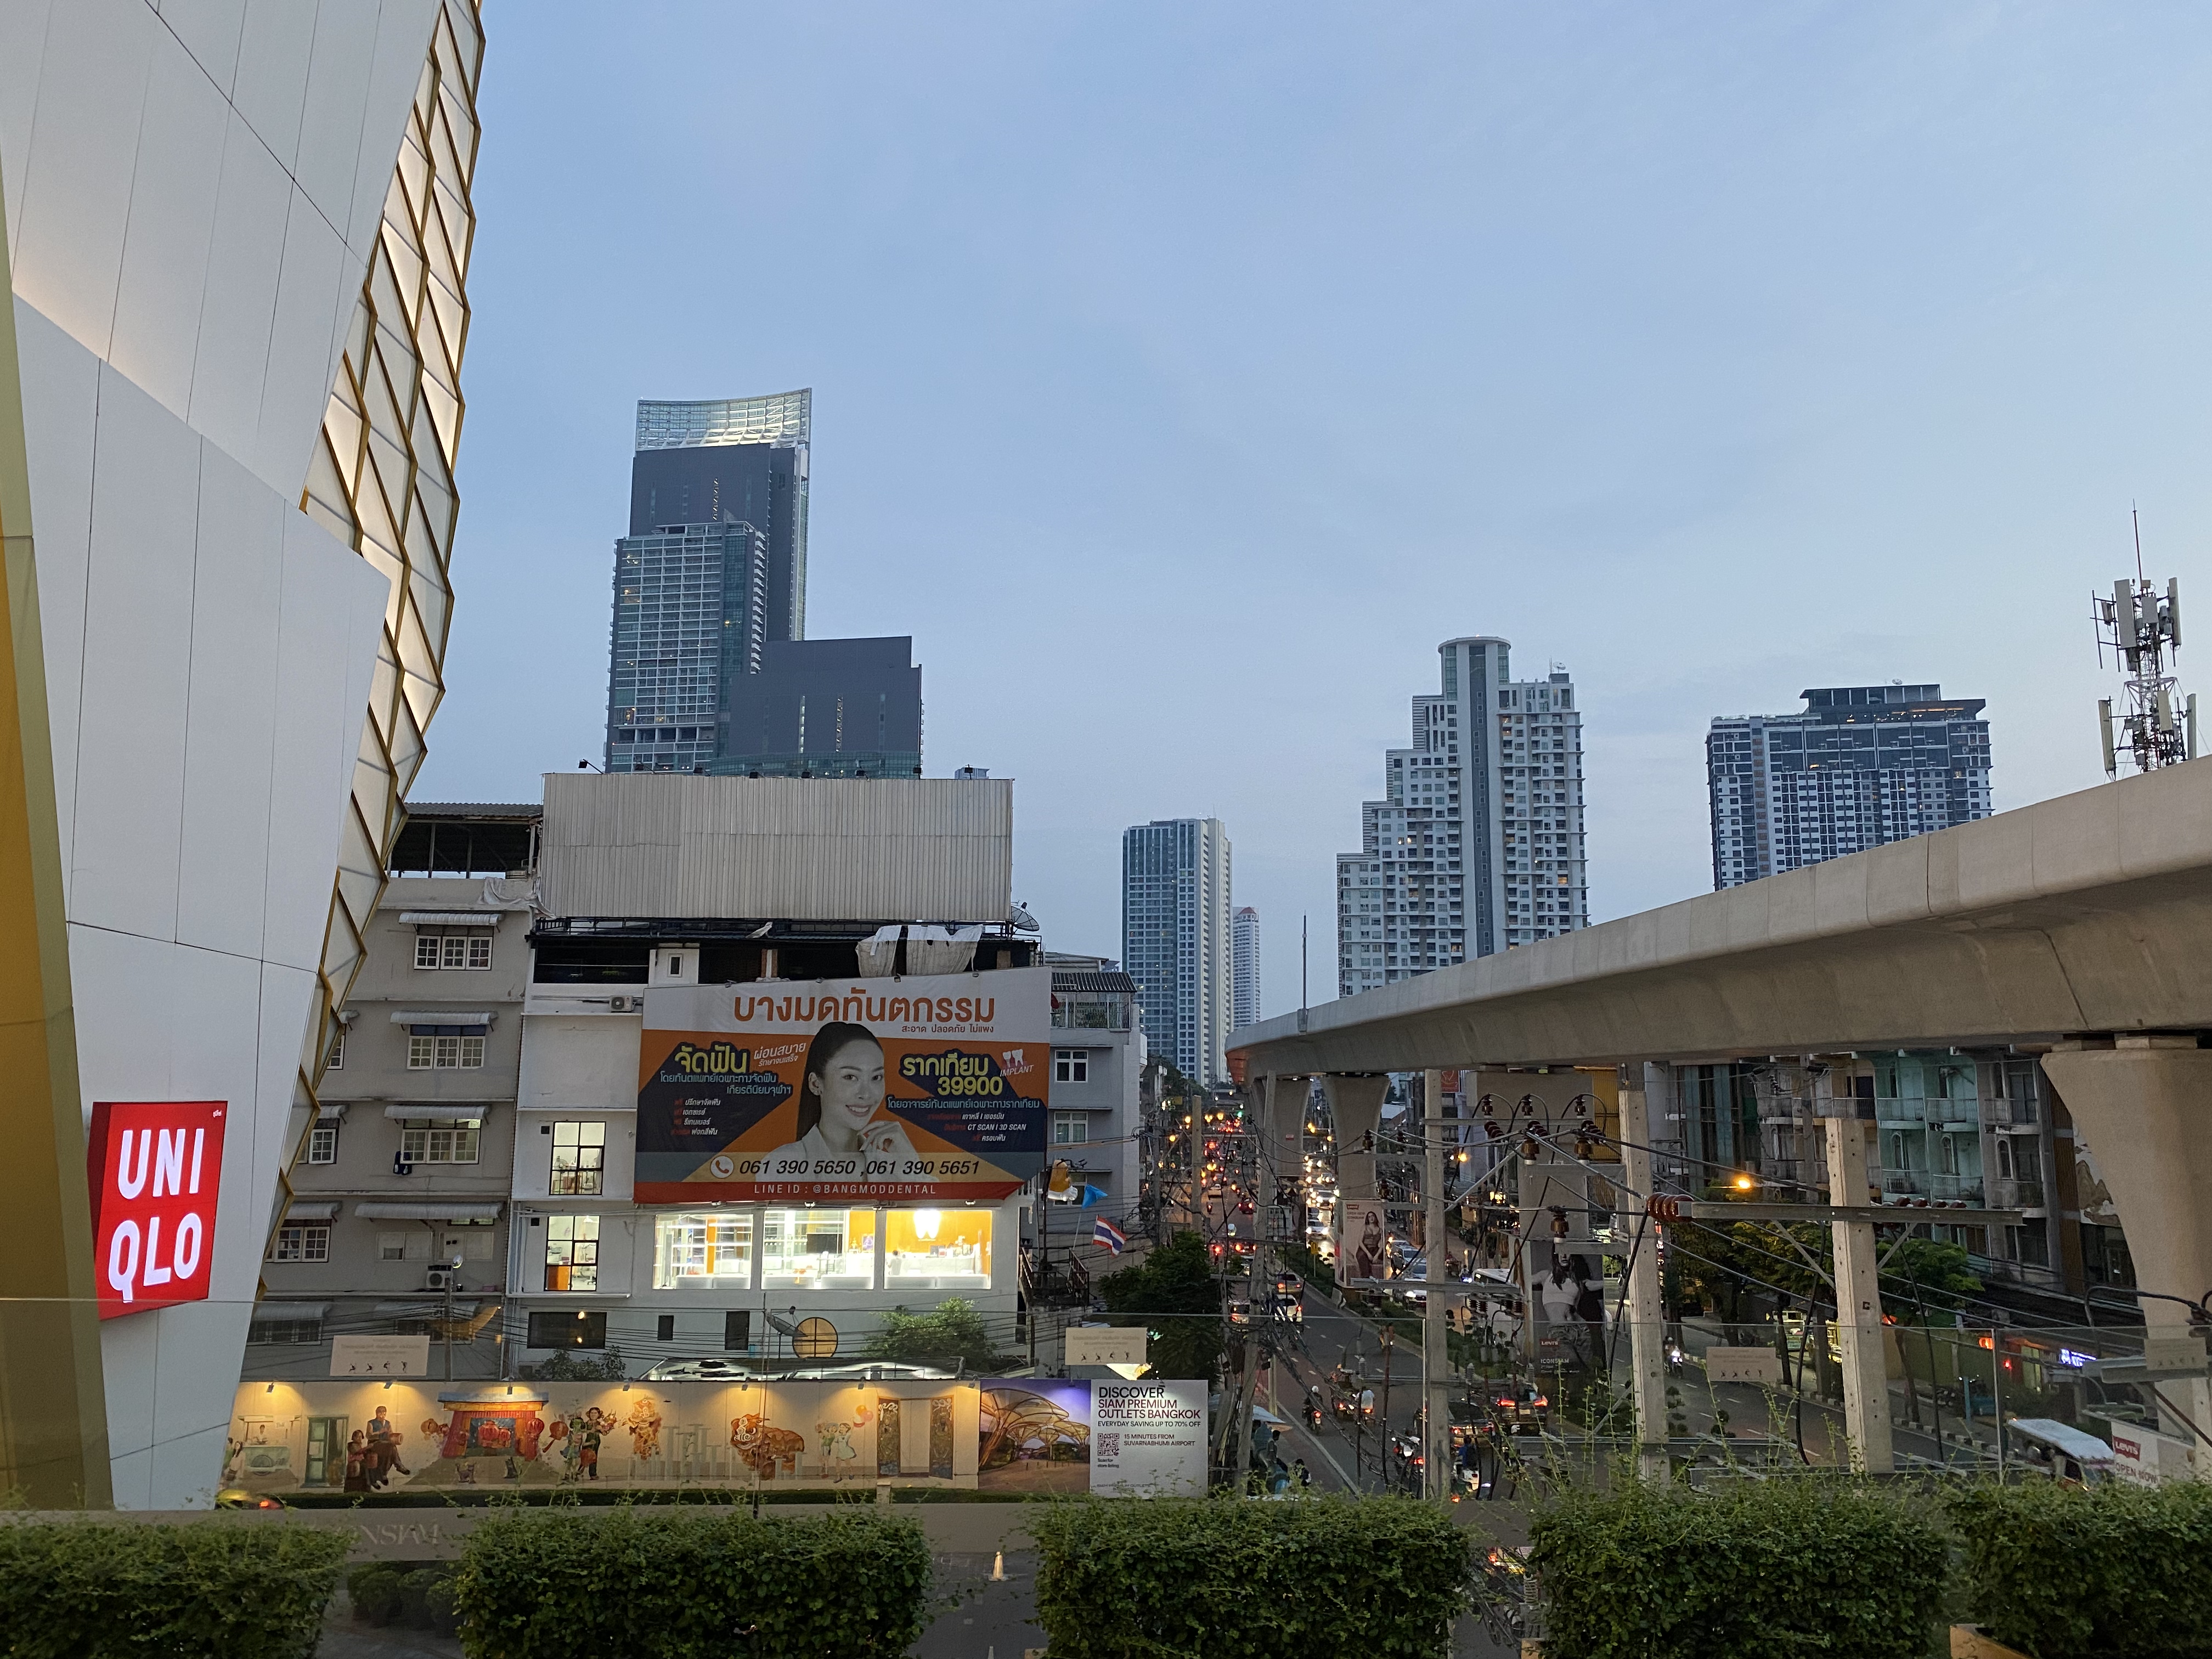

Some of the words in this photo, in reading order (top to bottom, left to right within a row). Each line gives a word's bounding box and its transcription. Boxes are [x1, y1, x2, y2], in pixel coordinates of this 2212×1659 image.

[734, 986, 995, 1023] บางมดทันตกรรม
[931, 1024, 966, 1033] ปลอดภัย
[969, 1024, 994, 1033] ไม่แพง
[754, 1042, 806, 1060] ผ่อนสบาย
[674, 1045, 747, 1073] จัดฟัน
[902, 1052, 989, 1076] รากเทียม
[1000, 1064, 1034, 1077] IMPLANT
[937, 1076, 1003, 1096] 39900
[117, 1127, 205, 1200] UNI
[740, 1160, 770, 1174] 061
[776, 1160, 809, 1174] 390
[813, 1160, 856, 1175] 5650
[902, 1160, 934, 1174] 390
[939, 1160, 980, 1175] 5651
[754, 1184, 783, 1194] LINE
[788, 1184, 800, 1194] ID
[812, 1184, 936, 1194] @BANGMODDENTAL
[108, 1212, 202, 1304] QLO
[1099, 1386, 1165, 1398] DISCOVER
[1098, 1399, 1125, 1408] SIAM
[1127, 1400, 1177, 1409] PREMIUM
[1098, 1409, 1146, 1419] OUTLETS
[1148, 1409, 1201, 1419] BANGKOK
[2115, 1463, 2136, 1477] OPEN
